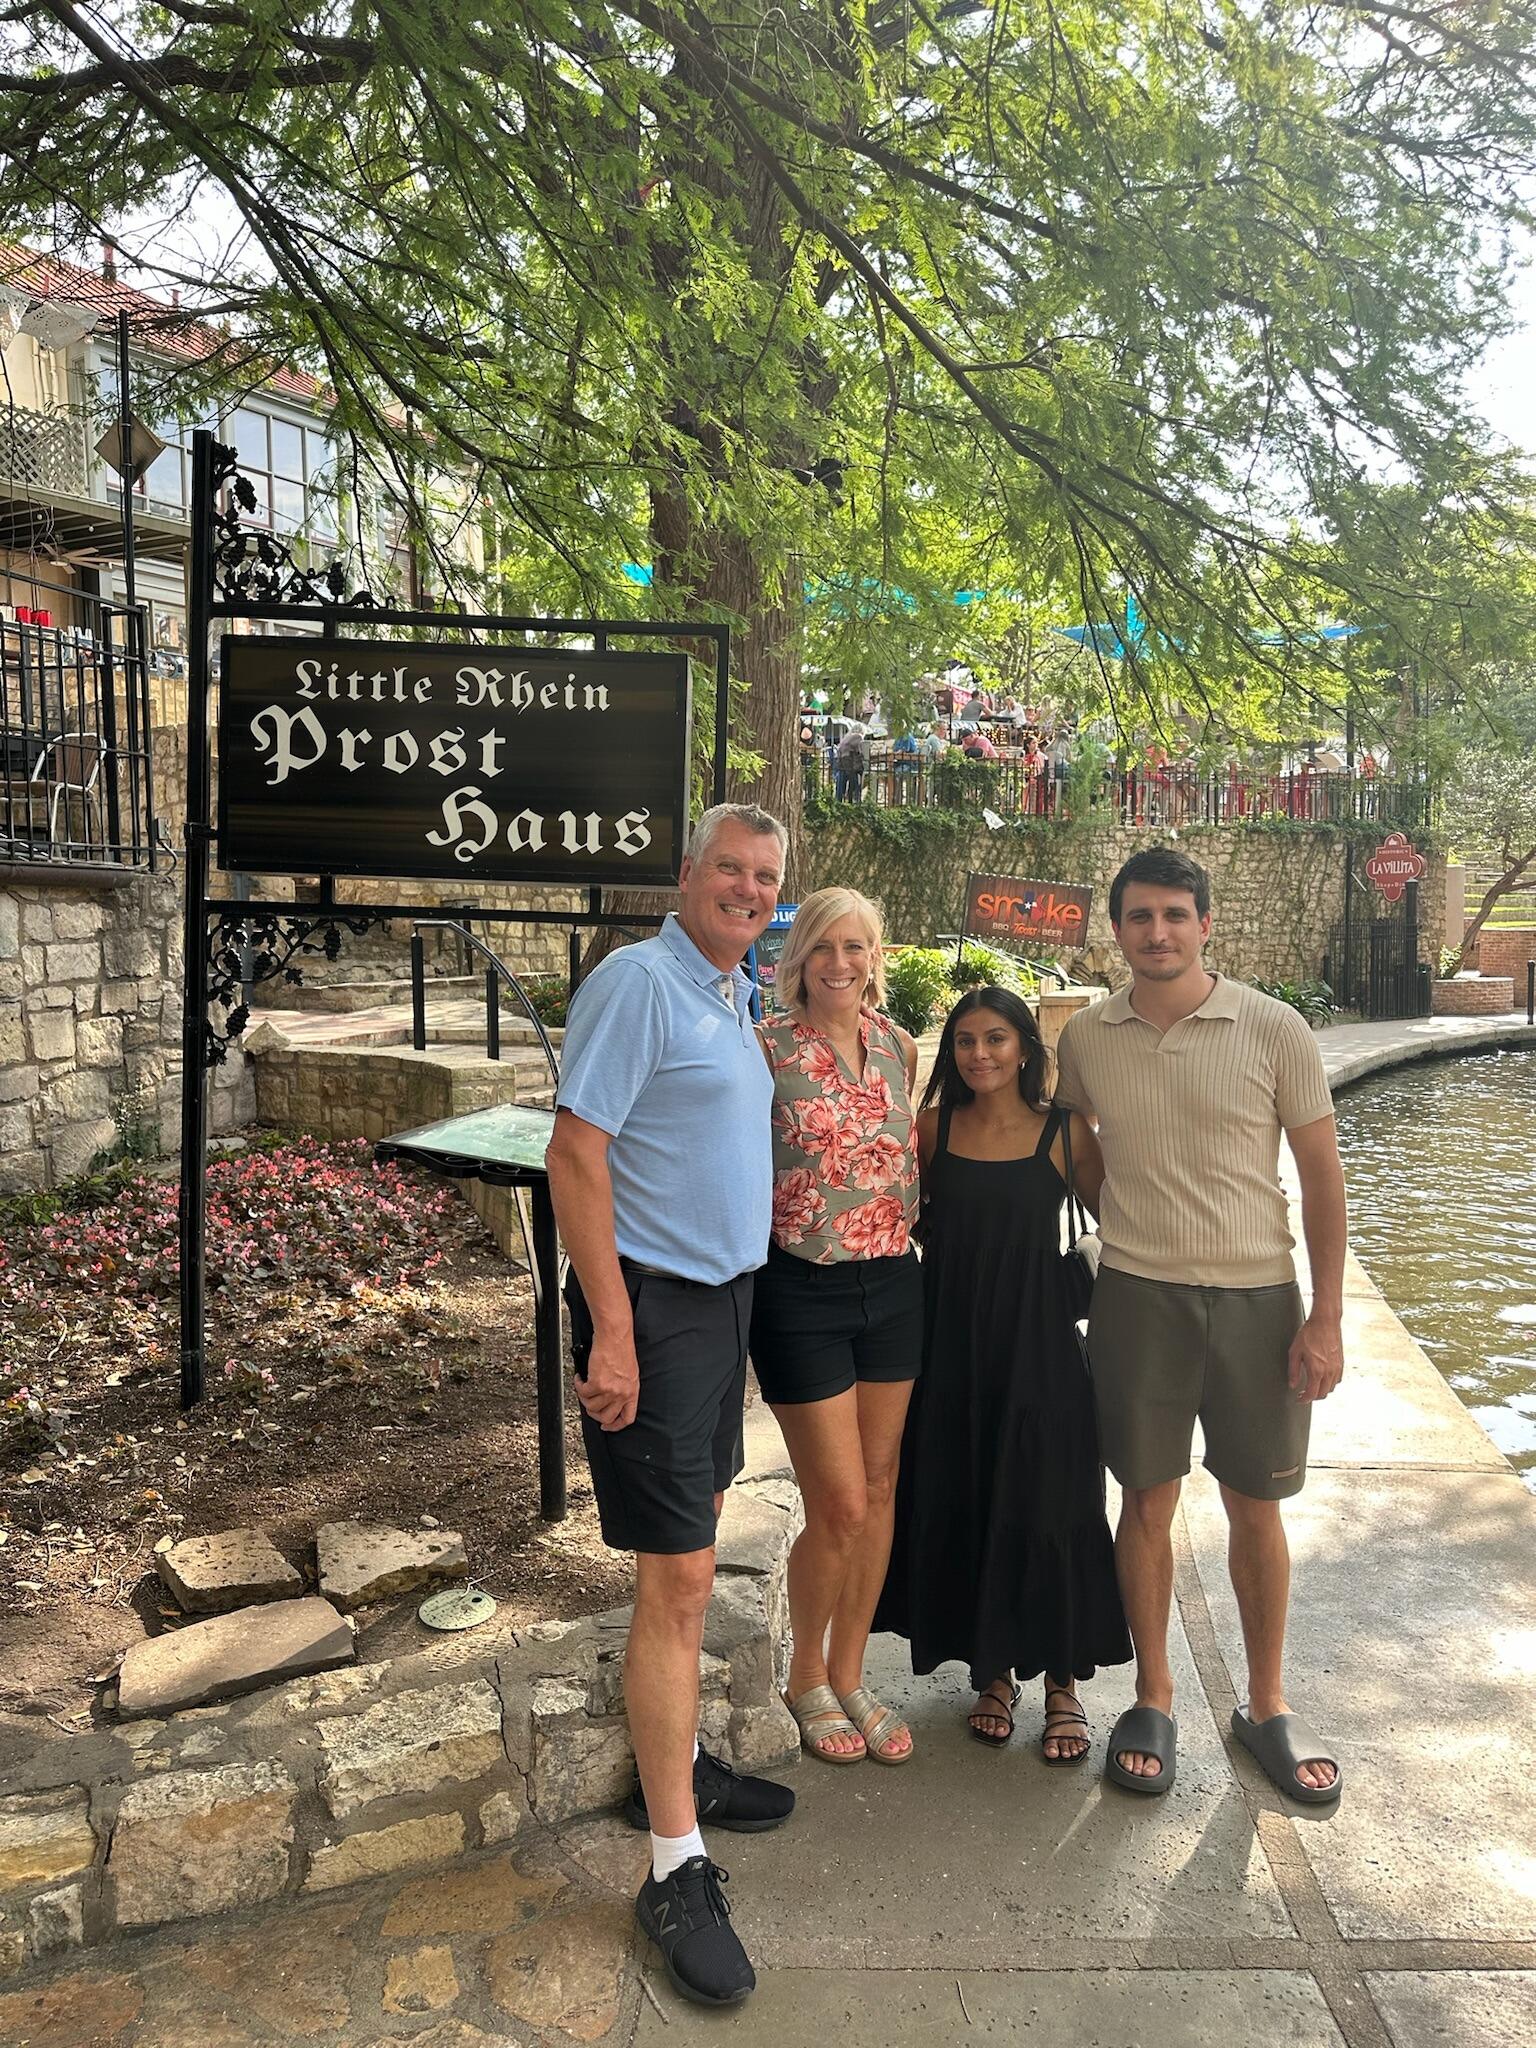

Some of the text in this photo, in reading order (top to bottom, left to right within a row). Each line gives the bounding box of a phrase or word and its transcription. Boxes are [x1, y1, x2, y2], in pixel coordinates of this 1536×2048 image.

[295, 659, 611, 715] Little Rhein
[250, 704, 506, 786] Prost
[425, 786, 653, 863] Haus
[992, 922, 1010, 932] BBQ
[1041, 928, 1064, 938] BEER
